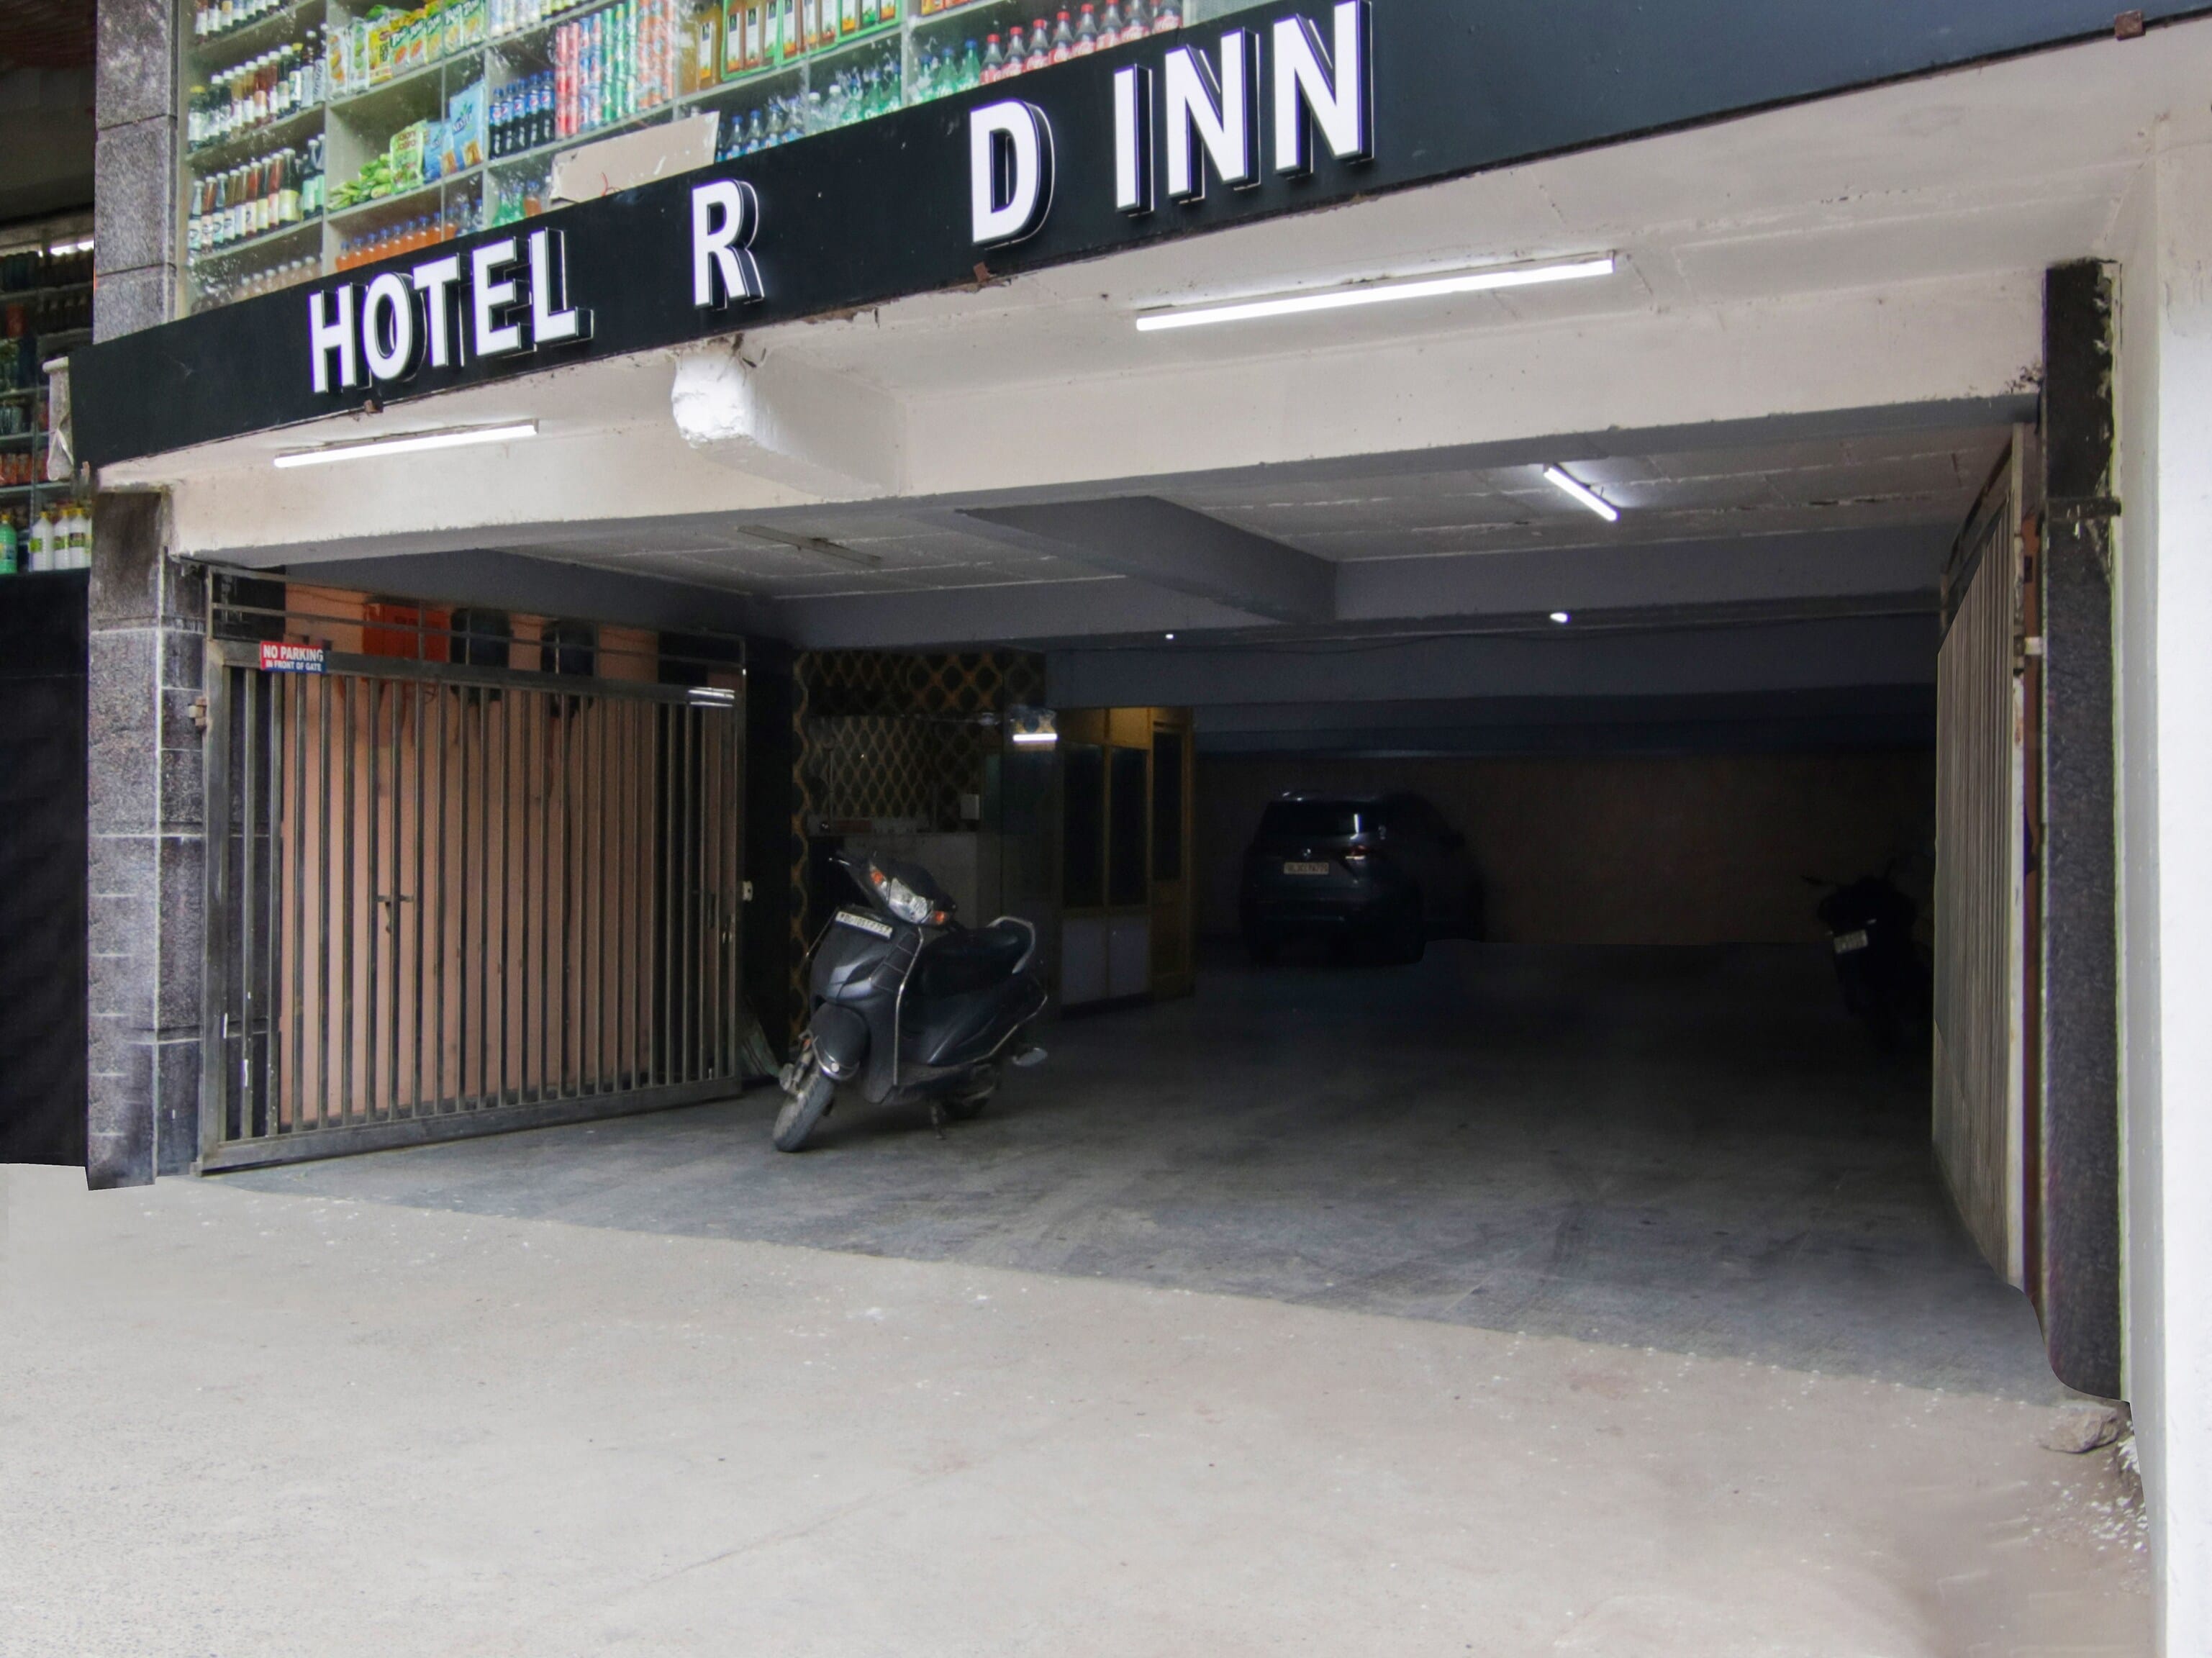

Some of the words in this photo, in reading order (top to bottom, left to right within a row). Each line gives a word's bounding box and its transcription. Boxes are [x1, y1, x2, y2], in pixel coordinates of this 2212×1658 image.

[309, 230, 587, 394] HOTEL
[692, 178, 760, 308] R
[970, 98, 1051, 245] D
[1114, 0, 1372, 213] INN
[263, 645, 278, 659] NO
[281, 645, 324, 662] PARKING
[266, 659, 273, 668] IN
[274, 660, 294, 670] FRONT
[296, 661, 304, 670] OF
[305, 662, 322, 671] GATE
